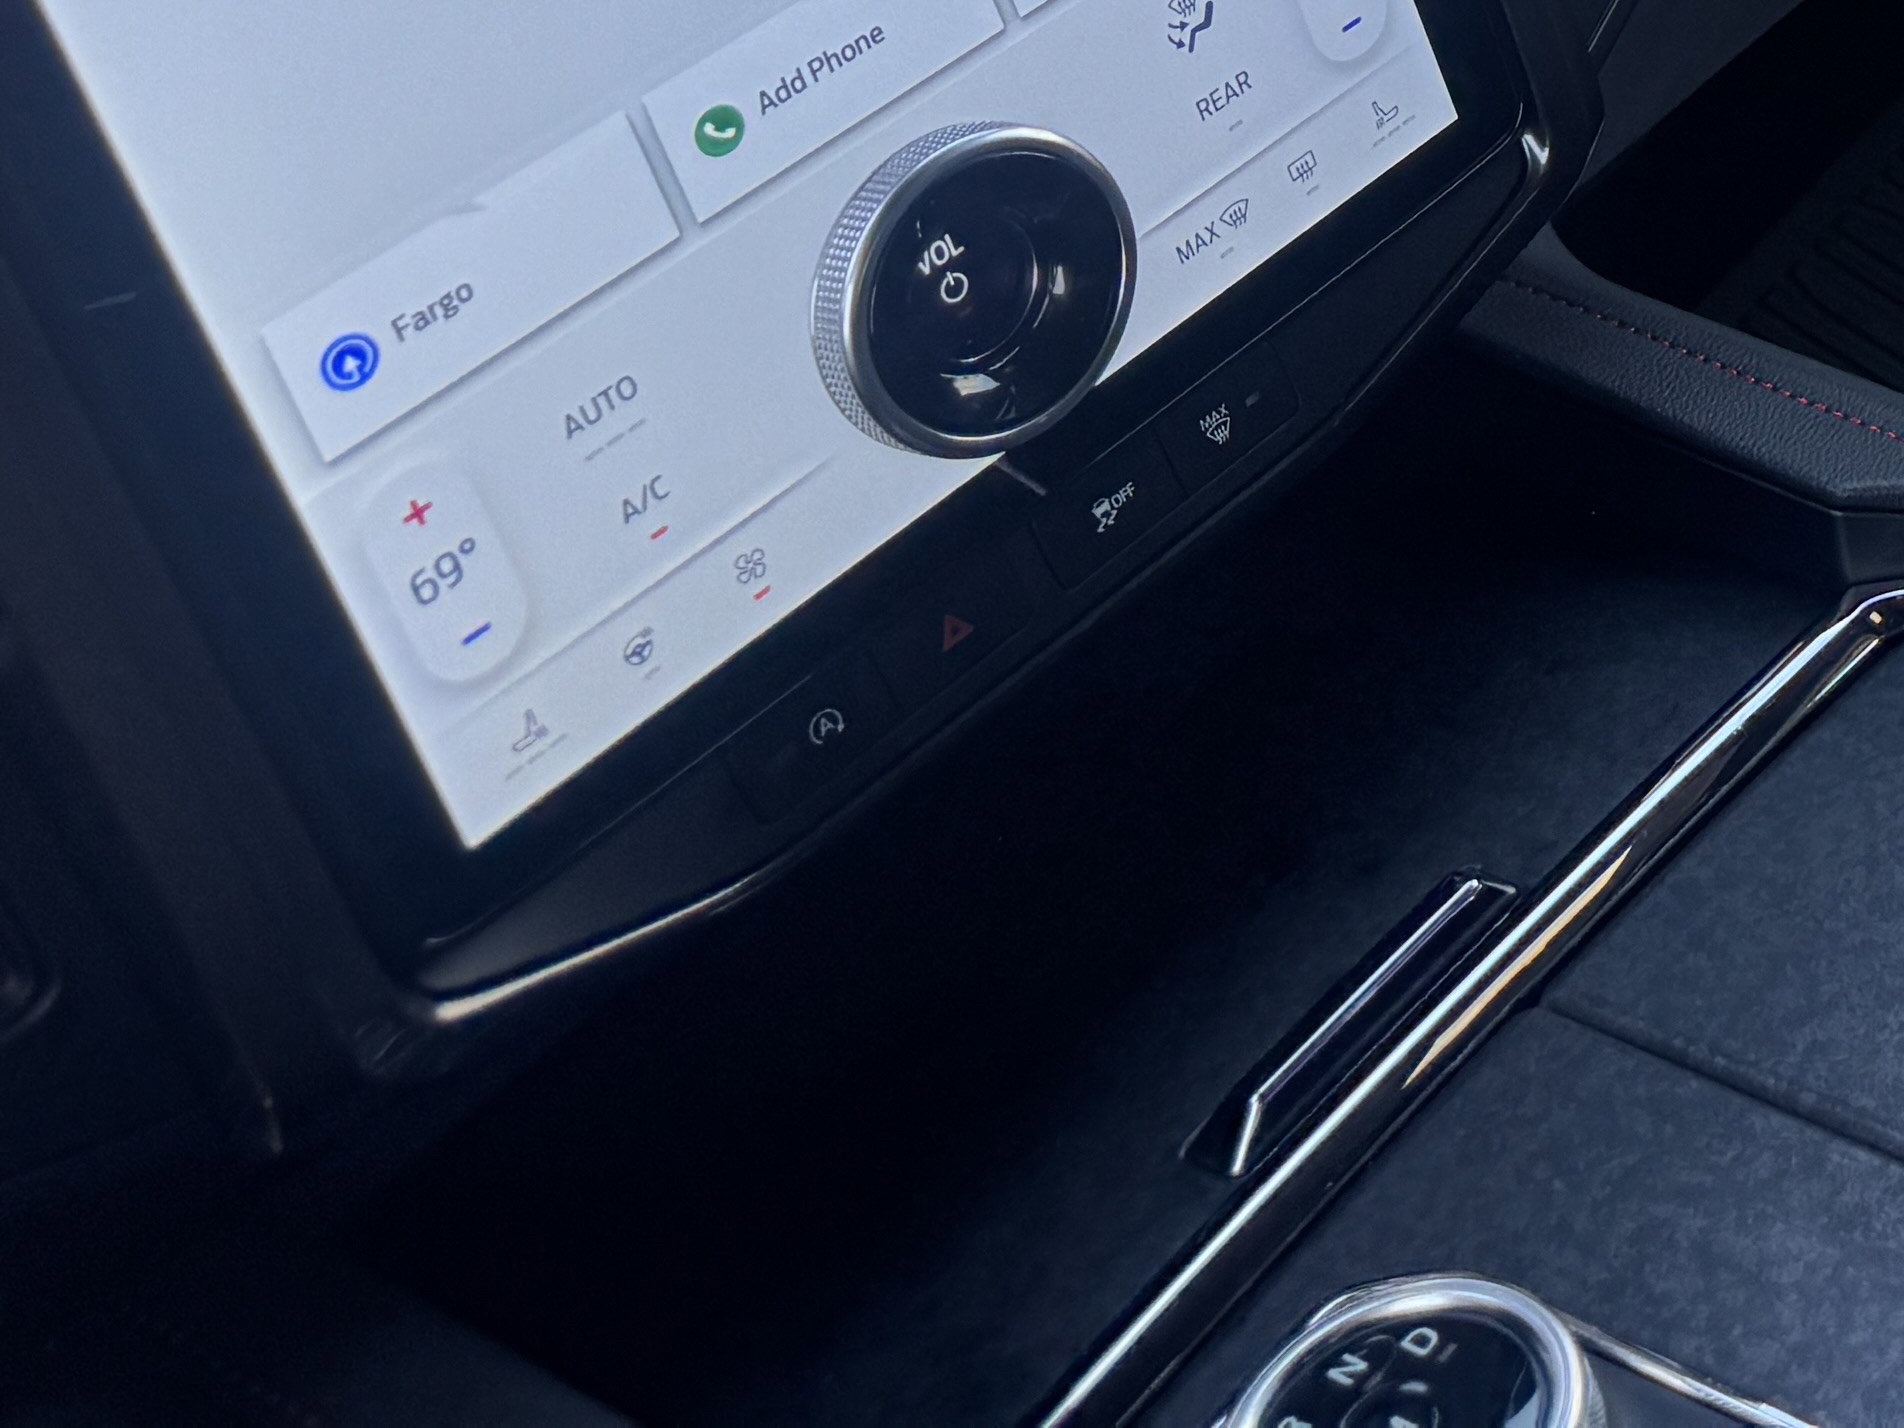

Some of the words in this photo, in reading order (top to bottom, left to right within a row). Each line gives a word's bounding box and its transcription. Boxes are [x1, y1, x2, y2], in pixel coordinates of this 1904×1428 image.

[758, 67, 809, 117] Add
[807, 24, 887, 84] Phone
[1195, 68, 1254, 123] REAR
[917, 233, 966, 277] VOL
[1176, 220, 1222, 266] MAX
[389, 280, 476, 343] Fargo
[562, 373, 640, 441] AUTO
[1199, 403, 1231, 432] MAX
[620, 474, 672, 525] A/C
[1109, 481, 1136, 510] OFF
[409, 535, 478, 608] 69°
